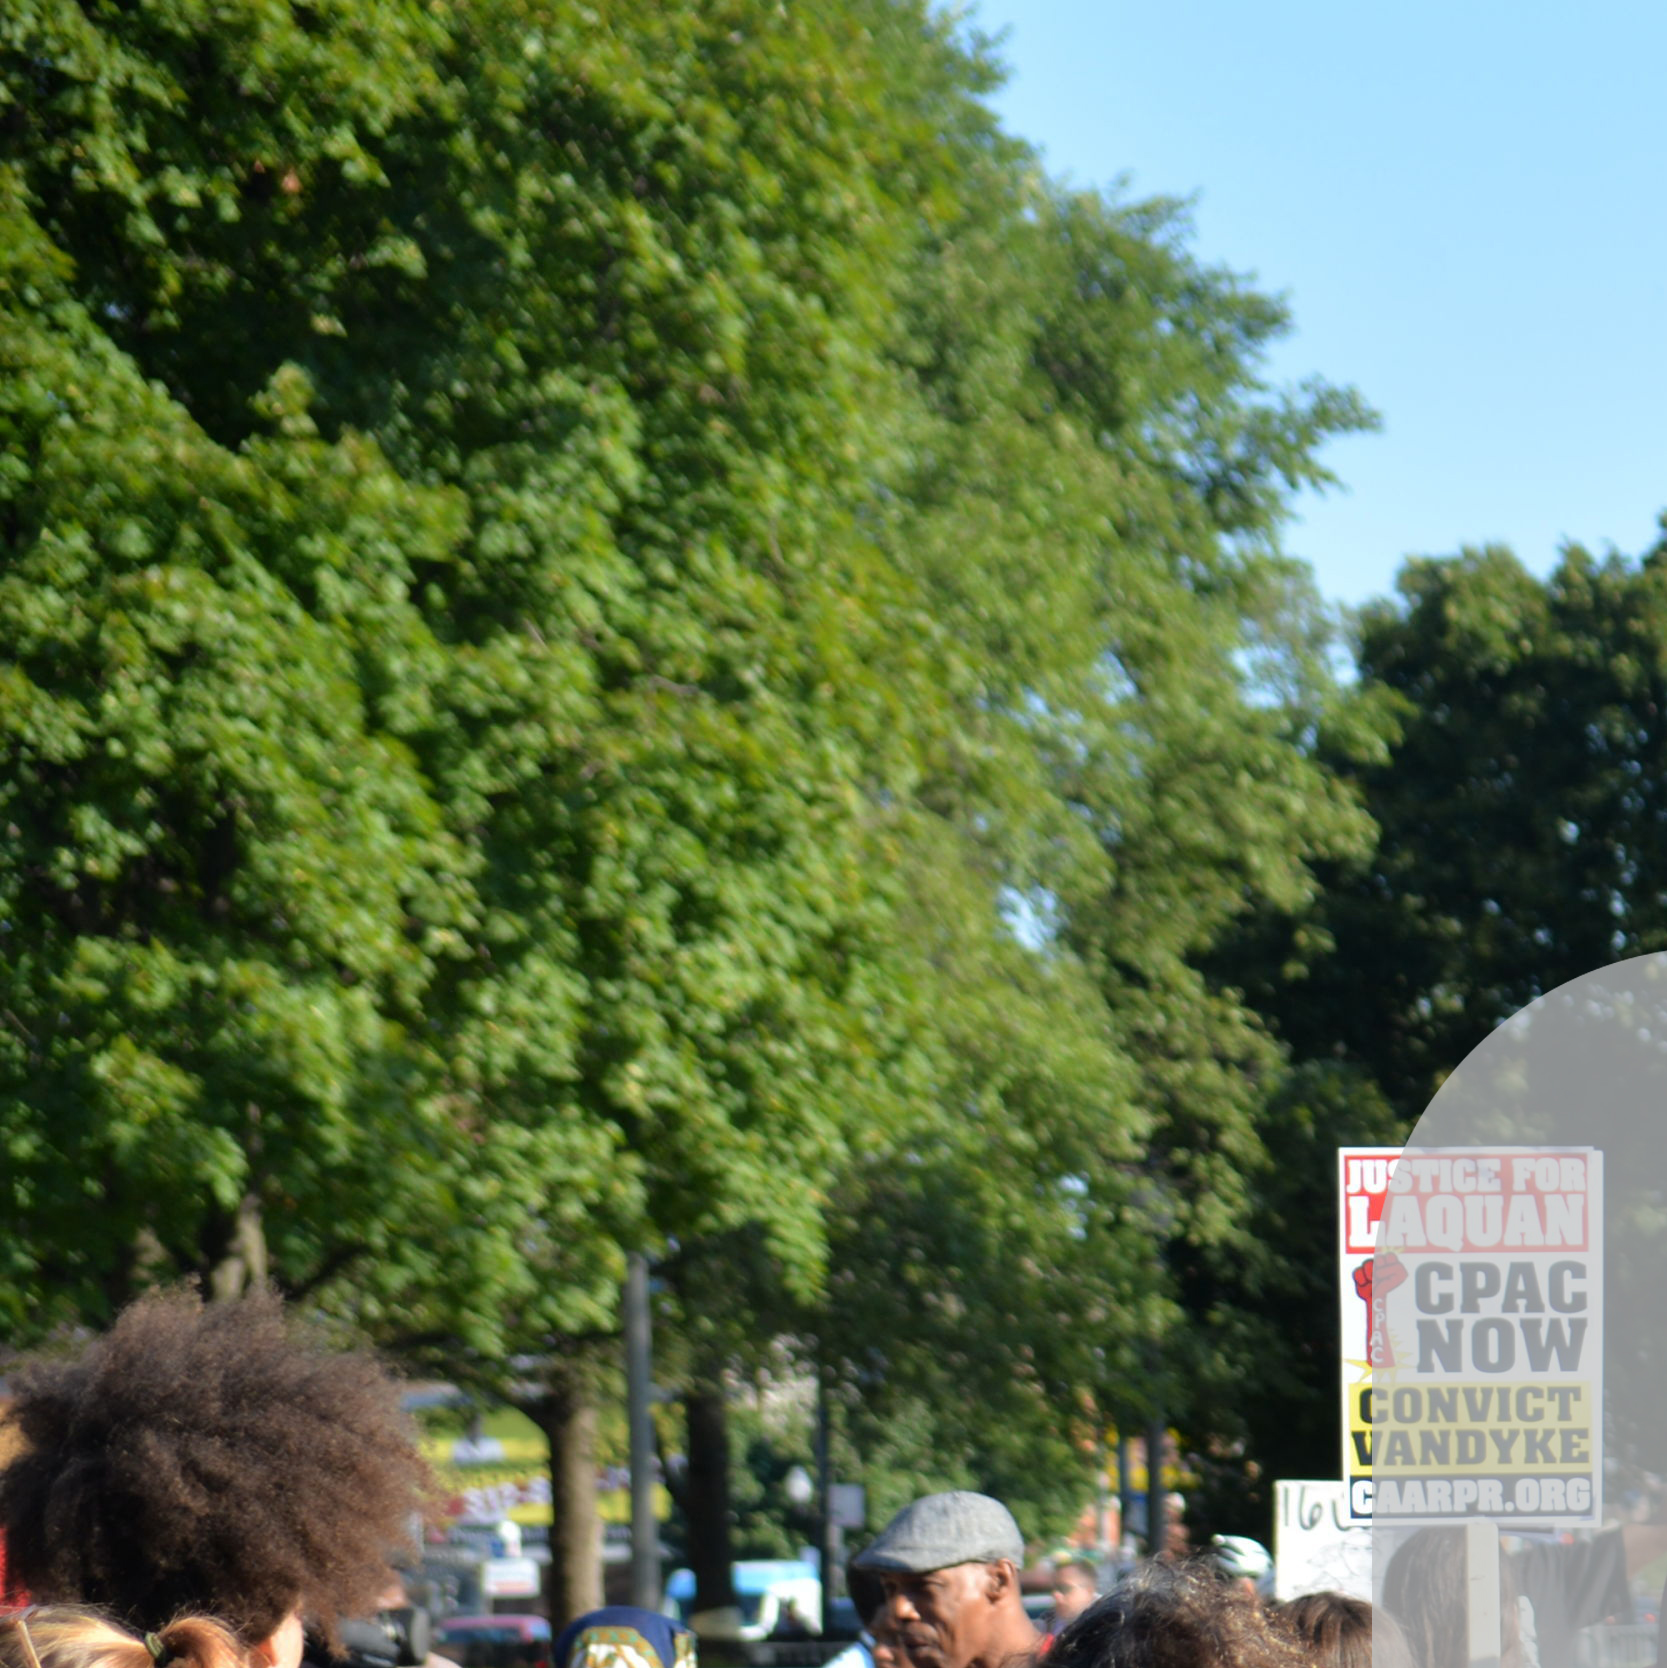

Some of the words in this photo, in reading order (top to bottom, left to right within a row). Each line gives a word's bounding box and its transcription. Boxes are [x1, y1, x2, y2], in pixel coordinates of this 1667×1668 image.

[1347, 1158, 1501, 1194] JUSTICE
[1511, 1157, 1586, 1193] FOR
[1349, 1194, 1585, 1252] LAQUAN
[1414, 1260, 1587, 1315] CPAC
[1371, 1298, 1386, 1363] CPAC
[1416, 1317, 1588, 1373] NOW
[1359, 1386, 1581, 1424] CONVICT
[1351, 1428, 1590, 1466] VANDYKE
[1351, 1477, 1591, 1515] CAARPR.ORG
